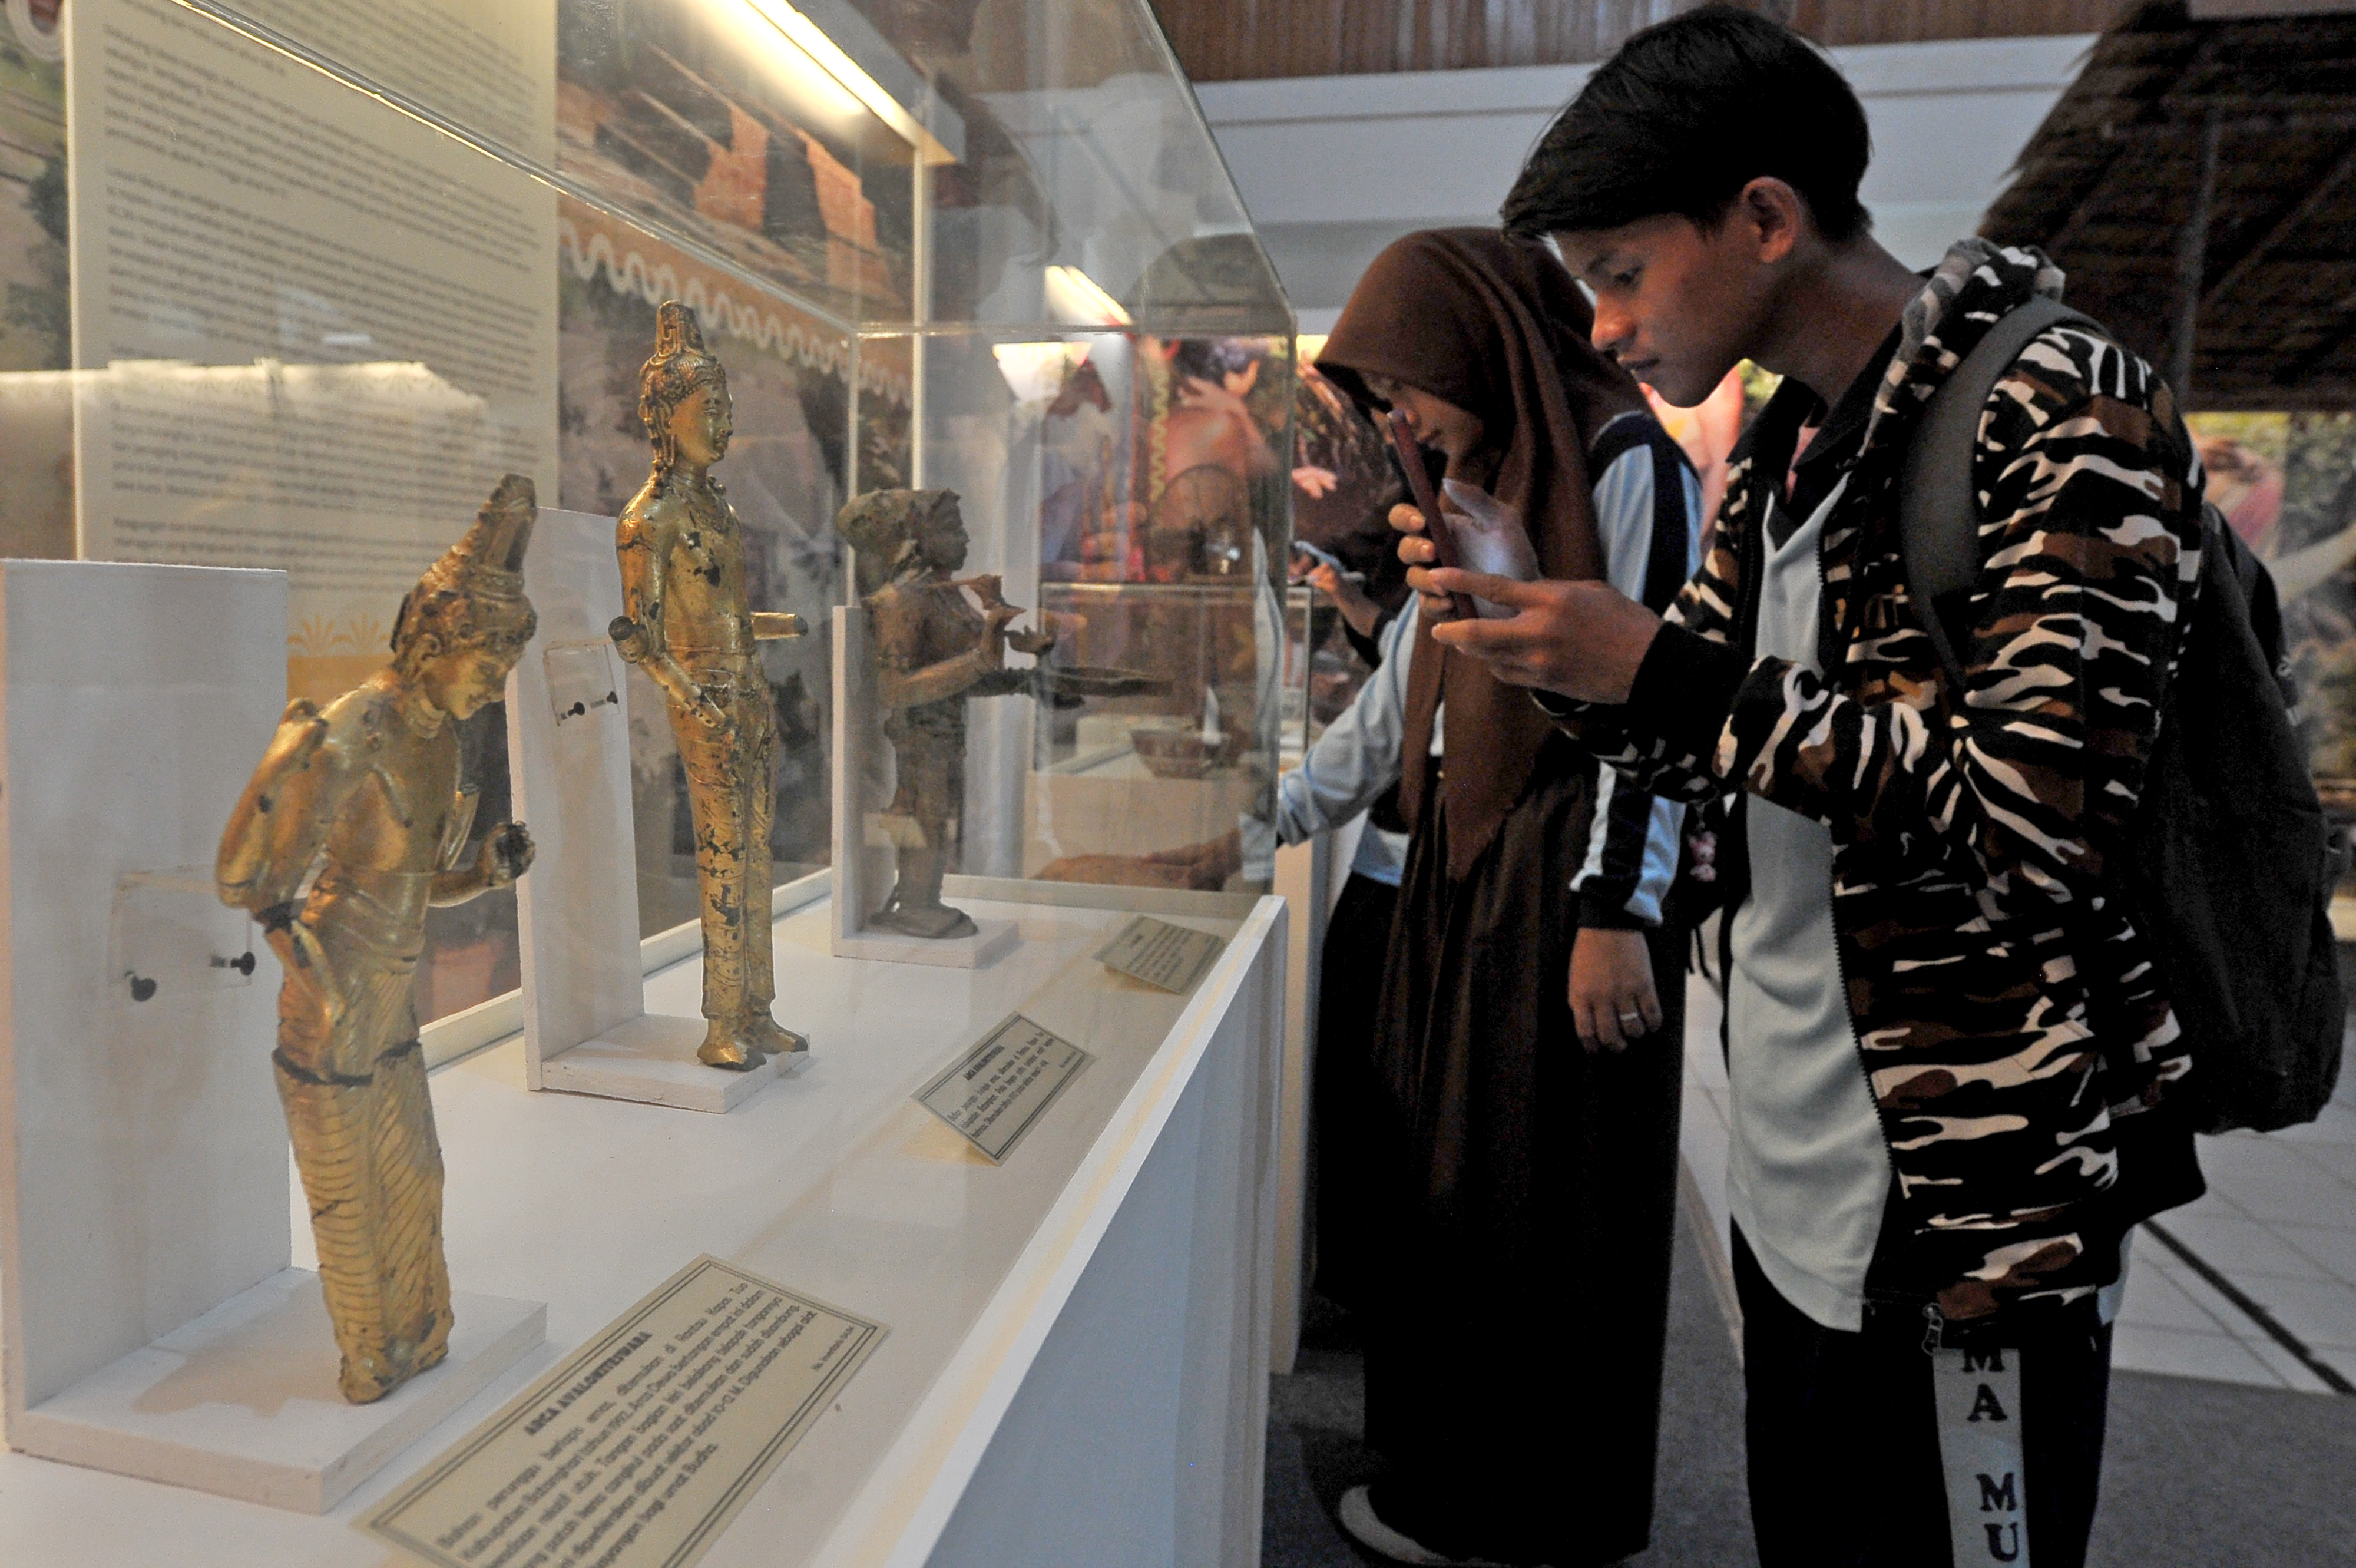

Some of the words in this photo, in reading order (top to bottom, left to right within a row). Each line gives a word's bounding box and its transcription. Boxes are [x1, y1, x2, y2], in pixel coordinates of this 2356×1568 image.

[436, 1514, 482, 1549] Bahan
[487, 1465, 541, 1510] perunggu
[540, 1427, 584, 1460] berlapis
[617, 1357, 663, 1396] ditemukan
[664, 1344, 677, 1354] di
[460, 1504, 528, 1561] Kabupaten
[522, 1454, 583, 1506] Batanghari
[577, 1428, 612, 1456] tahun
[628, 1390, 654, 1412] Arca
[647, 1369, 677, 1393] Dewa
[670, 1336, 714, 1372] bertangan
[710, 1315, 737, 1337] empat
[730, 1307, 745, 1318] ini
[740, 1290, 765, 1309] dalam
[524, 1408, 561, 1435] ARCA
[573, 1495, 637, 1559] diperkirakan
[634, 1464, 668, 1496] dibuat
[692, 1412, 717, 1437] abad
[738, 1348, 781, 1386] Digunakan
[777, 1323, 805, 1348] sebagai
[800, 1311, 817, 1324] alat
[595, 1434, 637, 1467] Tangan
[633, 1405, 668, 1434] bagian
[679, 1356, 721, 1390] belakang
[743, 1297, 782, 1329] tangannya
[641, 1433, 669, 1458] pada
[684, 1374, 727, 1415] ditemukan
[725, 1359, 743, 1374] dan
[740, 1339, 765, 1359] sudah
[637, 1498, 666, 1522] bagi
[662, 1473, 690, 1500] umat
